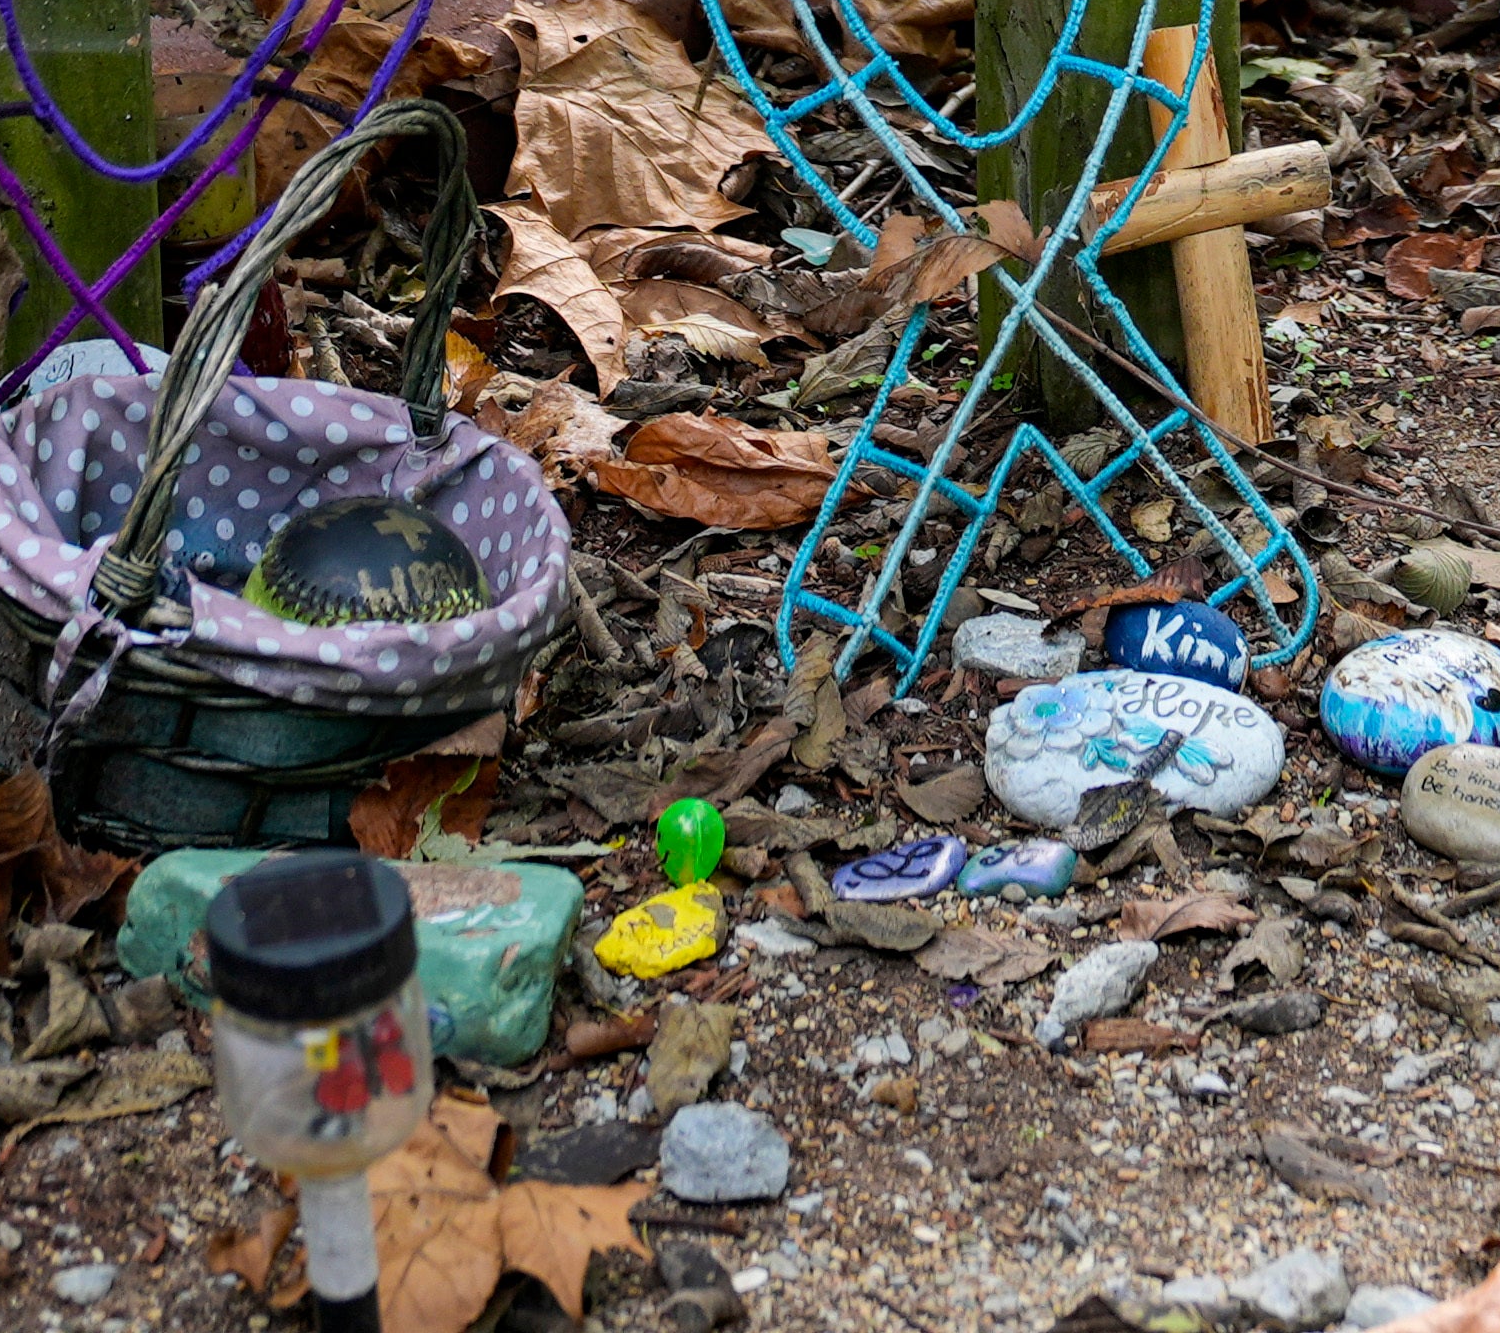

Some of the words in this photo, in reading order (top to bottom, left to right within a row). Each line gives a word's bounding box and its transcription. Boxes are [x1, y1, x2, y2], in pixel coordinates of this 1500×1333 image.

[1119, 678, 1258, 735] Hope
[1430, 758, 1458, 778] Be
[1420, 773, 1444, 795] Be
